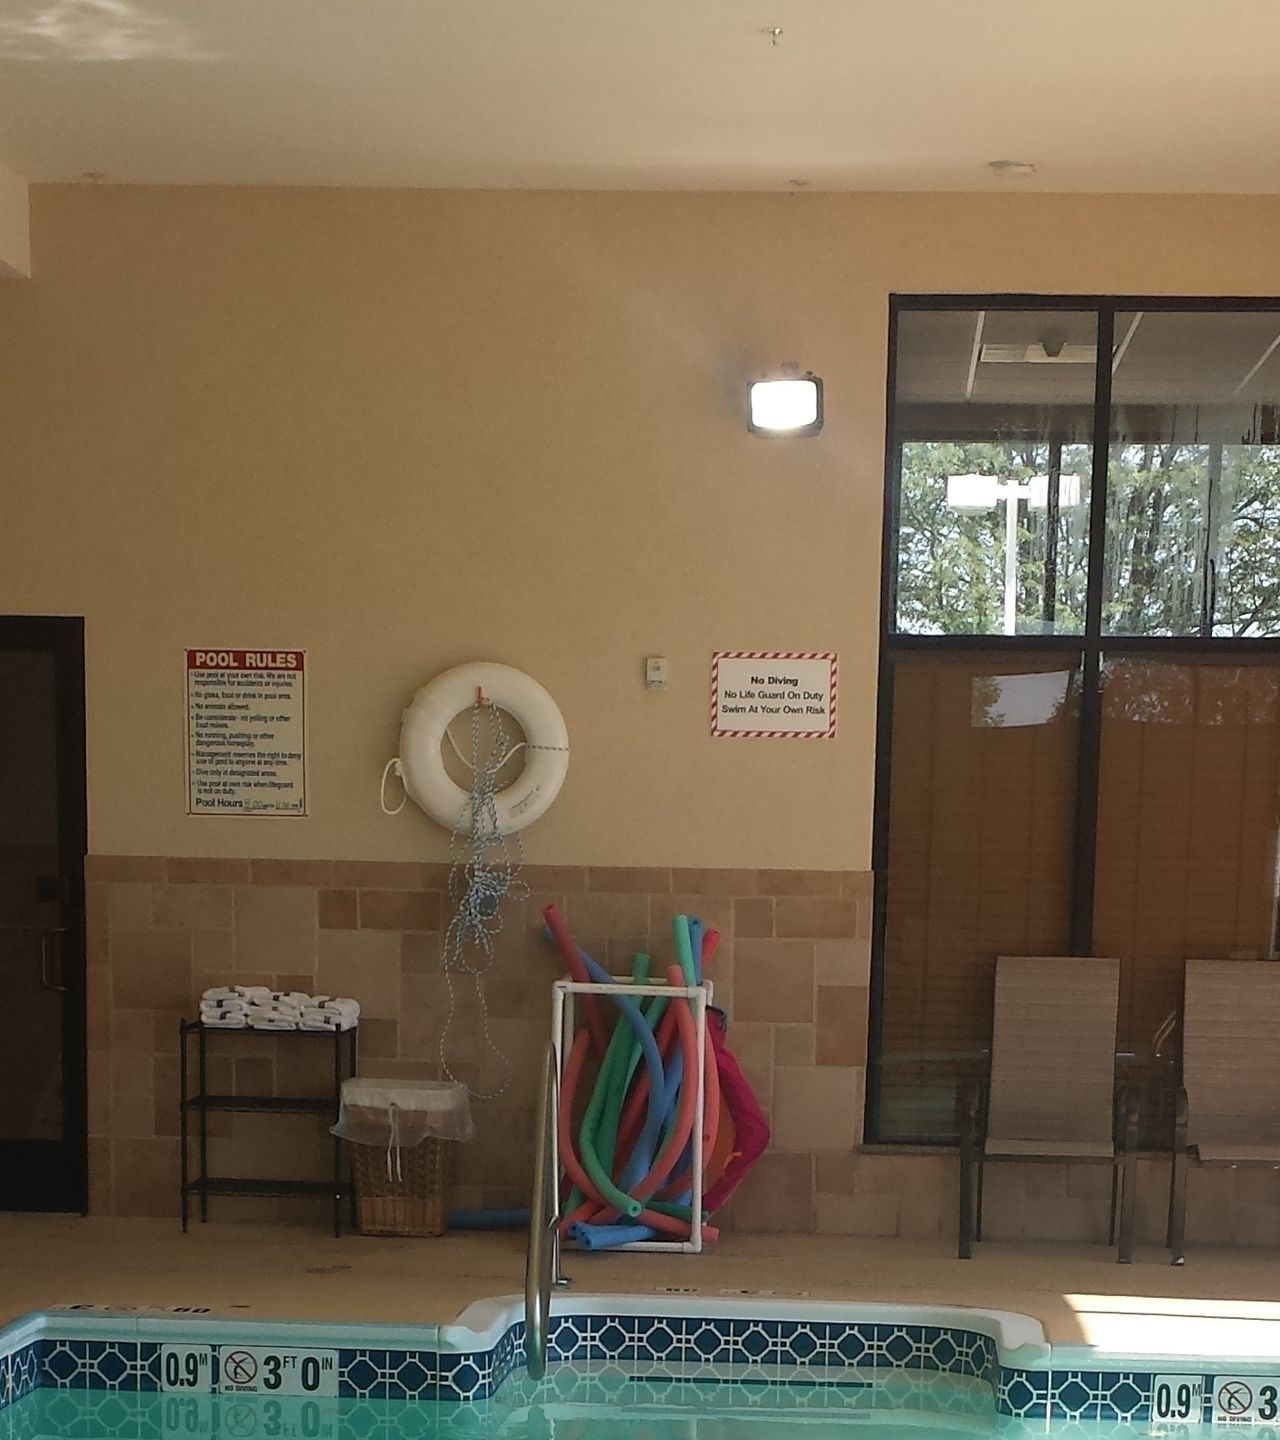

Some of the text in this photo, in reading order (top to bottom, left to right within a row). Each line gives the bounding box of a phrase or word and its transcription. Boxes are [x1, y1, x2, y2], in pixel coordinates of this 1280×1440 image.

[196, 652, 296, 667] POOL RULES
[768, 677, 798, 686] Diving
[725, 690, 737, 698] No
[758, 691, 785, 699] Guard
[803, 692, 823, 701] Duty
[722, 705, 825, 714] Swim At Your Own Risk
[196, 798, 215, 806] Pool
[218, 799, 242, 807] Hours
